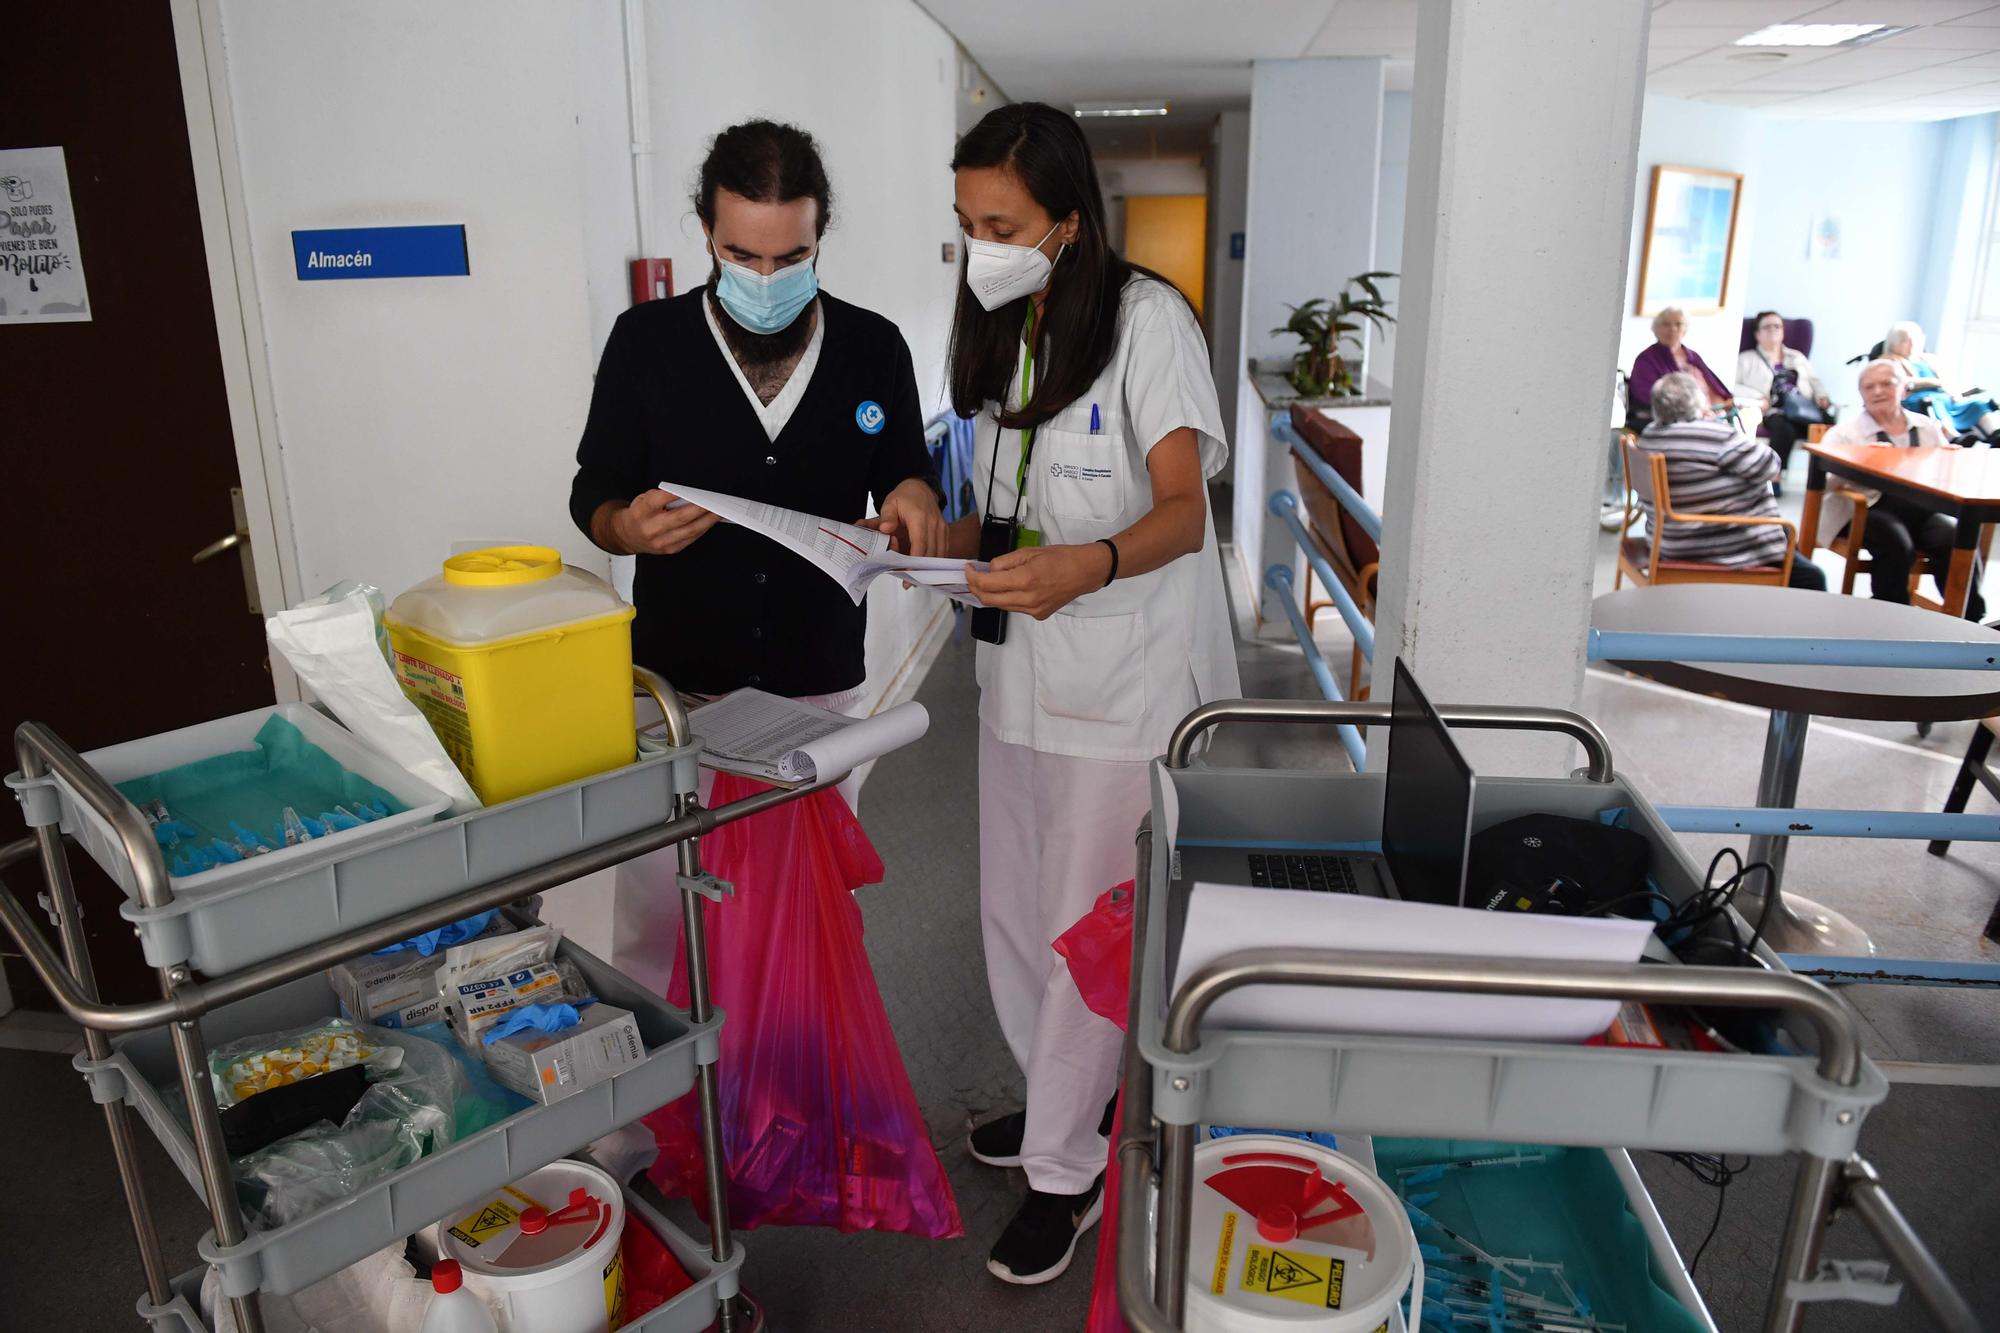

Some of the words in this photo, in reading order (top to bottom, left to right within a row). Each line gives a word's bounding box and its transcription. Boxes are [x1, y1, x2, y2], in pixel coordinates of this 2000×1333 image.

[11, 206, 27, 217] SOLO
[29, 204, 53, 216] PUEDES
[27, 240, 37, 250] DE
[39, 239, 58, 250] BUEN
[307, 250, 372, 268] Almacén
[463, 983, 487, 993] 0370
[469, 1005, 486, 1015] NR
[488, 998, 516, 1010] FFP2
[626, 1034, 640, 1060] denia
[450, 1230, 479, 1246] PELIGRO
[1328, 1262, 1344, 1306] PELIGRO
